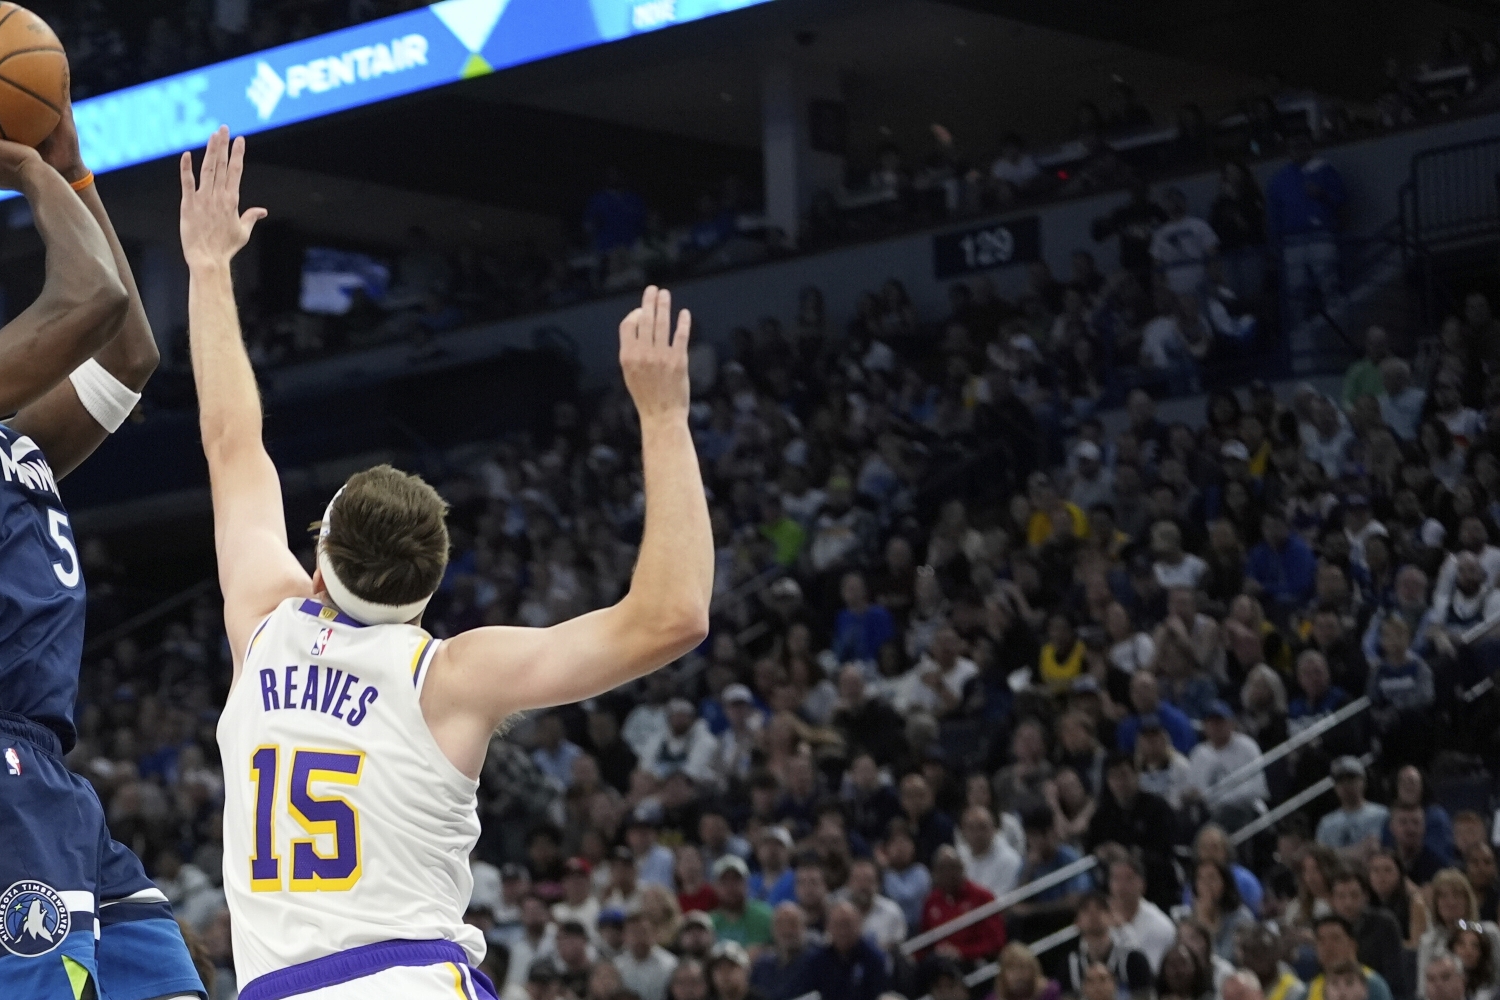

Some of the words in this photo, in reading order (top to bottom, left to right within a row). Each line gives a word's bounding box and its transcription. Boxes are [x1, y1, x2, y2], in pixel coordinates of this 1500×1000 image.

[284, 33, 429, 99] PENTAIR
[960, 226, 1014, 265] 129
[47, 508, 80, 588] 5
[259, 664, 379, 727] REAVES
[249, 743, 366, 892] 15
[21, 884, 67, 935] TIMBERWOLVES
